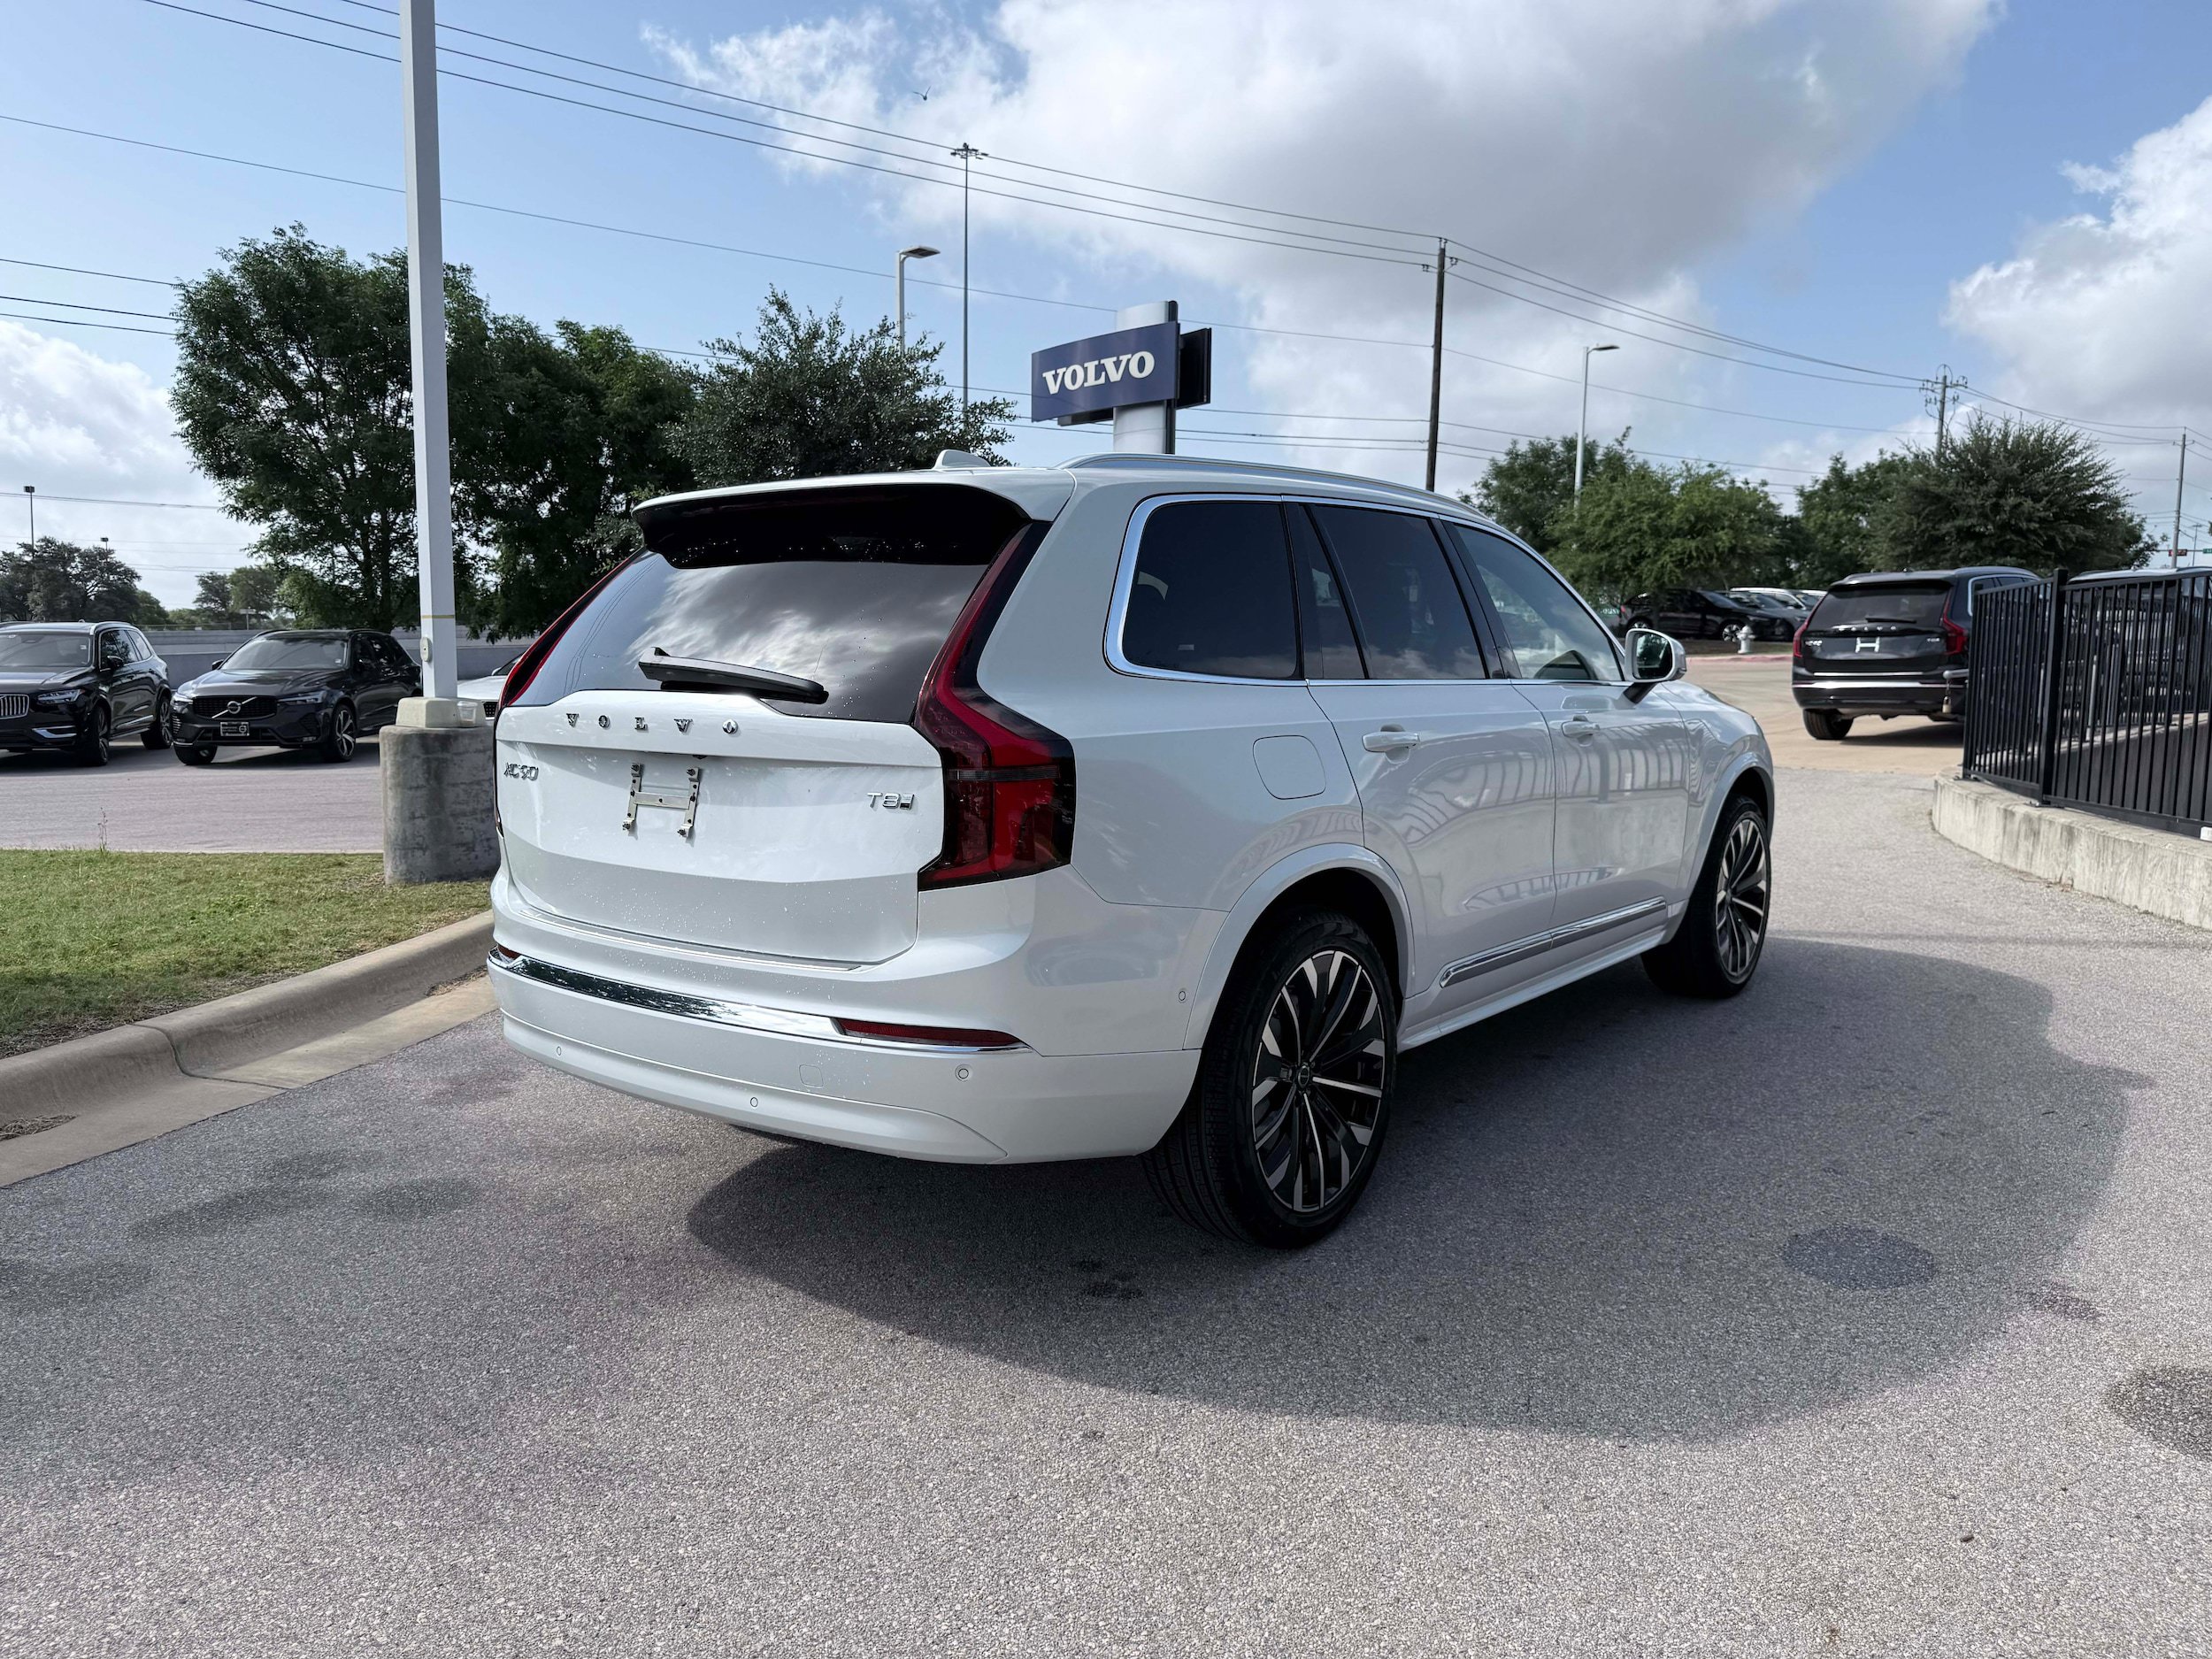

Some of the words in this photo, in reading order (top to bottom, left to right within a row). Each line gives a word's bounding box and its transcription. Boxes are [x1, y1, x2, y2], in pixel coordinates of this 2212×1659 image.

[1042, 350, 1155, 395] VOLVO
[565, 712, 739, 735] VOLVO
[503, 762, 539, 780] XC90
